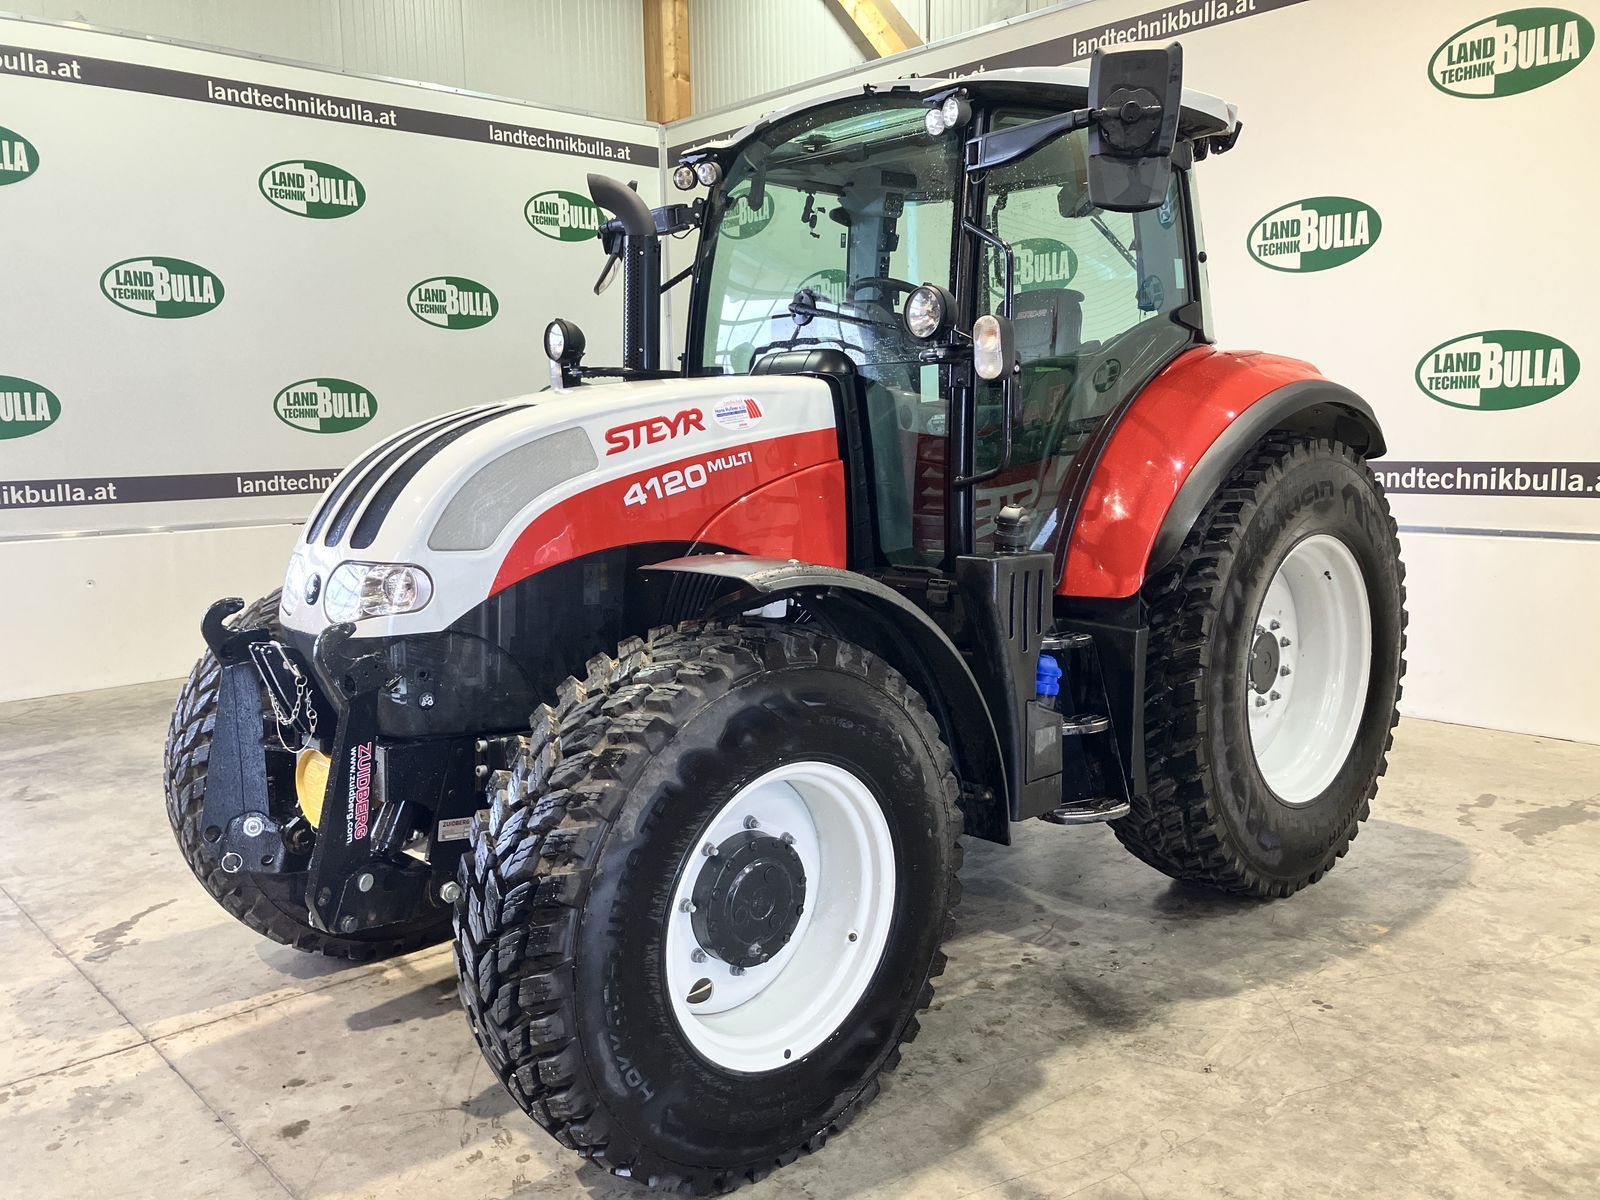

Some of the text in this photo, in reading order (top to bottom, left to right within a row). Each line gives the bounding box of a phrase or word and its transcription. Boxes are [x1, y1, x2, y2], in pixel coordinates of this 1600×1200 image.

[1446, 36, 1495, 66] LAND
[1495, 20, 1580, 75] BULLA
[0, 52, 81, 80] ulla.at
[1440, 60, 1495, 85] TECHNIK
[207, 80, 397, 126] landtechnikbulla.at
[0, 139, 29, 172] LA
[489, 125, 630, 160] landtechnikbulla.at
[271, 170, 305, 189] LAND
[304, 168, 358, 206] BULLA
[268, 187, 306, 202] TECHNIK
[533, 200, 559, 216] LAND
[531, 215, 560, 227] TECHNIK
[558, 198, 599, 231] BULLA
[1262, 218, 1301, 241] LAND
[1300, 209, 1370, 252] BULLA
[1257, 239, 1301, 257] TECHNIK
[115, 269, 154, 288] LAND
[1020, 248, 1070, 285] BULLA
[111, 287, 156, 301] TECHNIK
[152, 265, 216, 303] BULLA
[418, 287, 447, 303] LAND
[415, 303, 447, 315] TECHNIK
[446, 284, 492, 317] BULLA
[1434, 352, 1481, 374] LAND
[1480, 342, 1566, 389] BULLA
[1427, 375, 1481, 390] TECHNIK
[283, 407, 320, 419] TECHNIK
[286, 391, 319, 407] LAND
[318, 386, 371, 419] BULLA
[604, 408, 707, 456] STEYR
[623, 451, 753, 507] 4120 MULTI
[1374, 466, 1600, 492] andtechnikbulla.
[346, 746, 357, 845] www.zuidberg.com
[354, 741, 372, 840] ZUIDBERG
